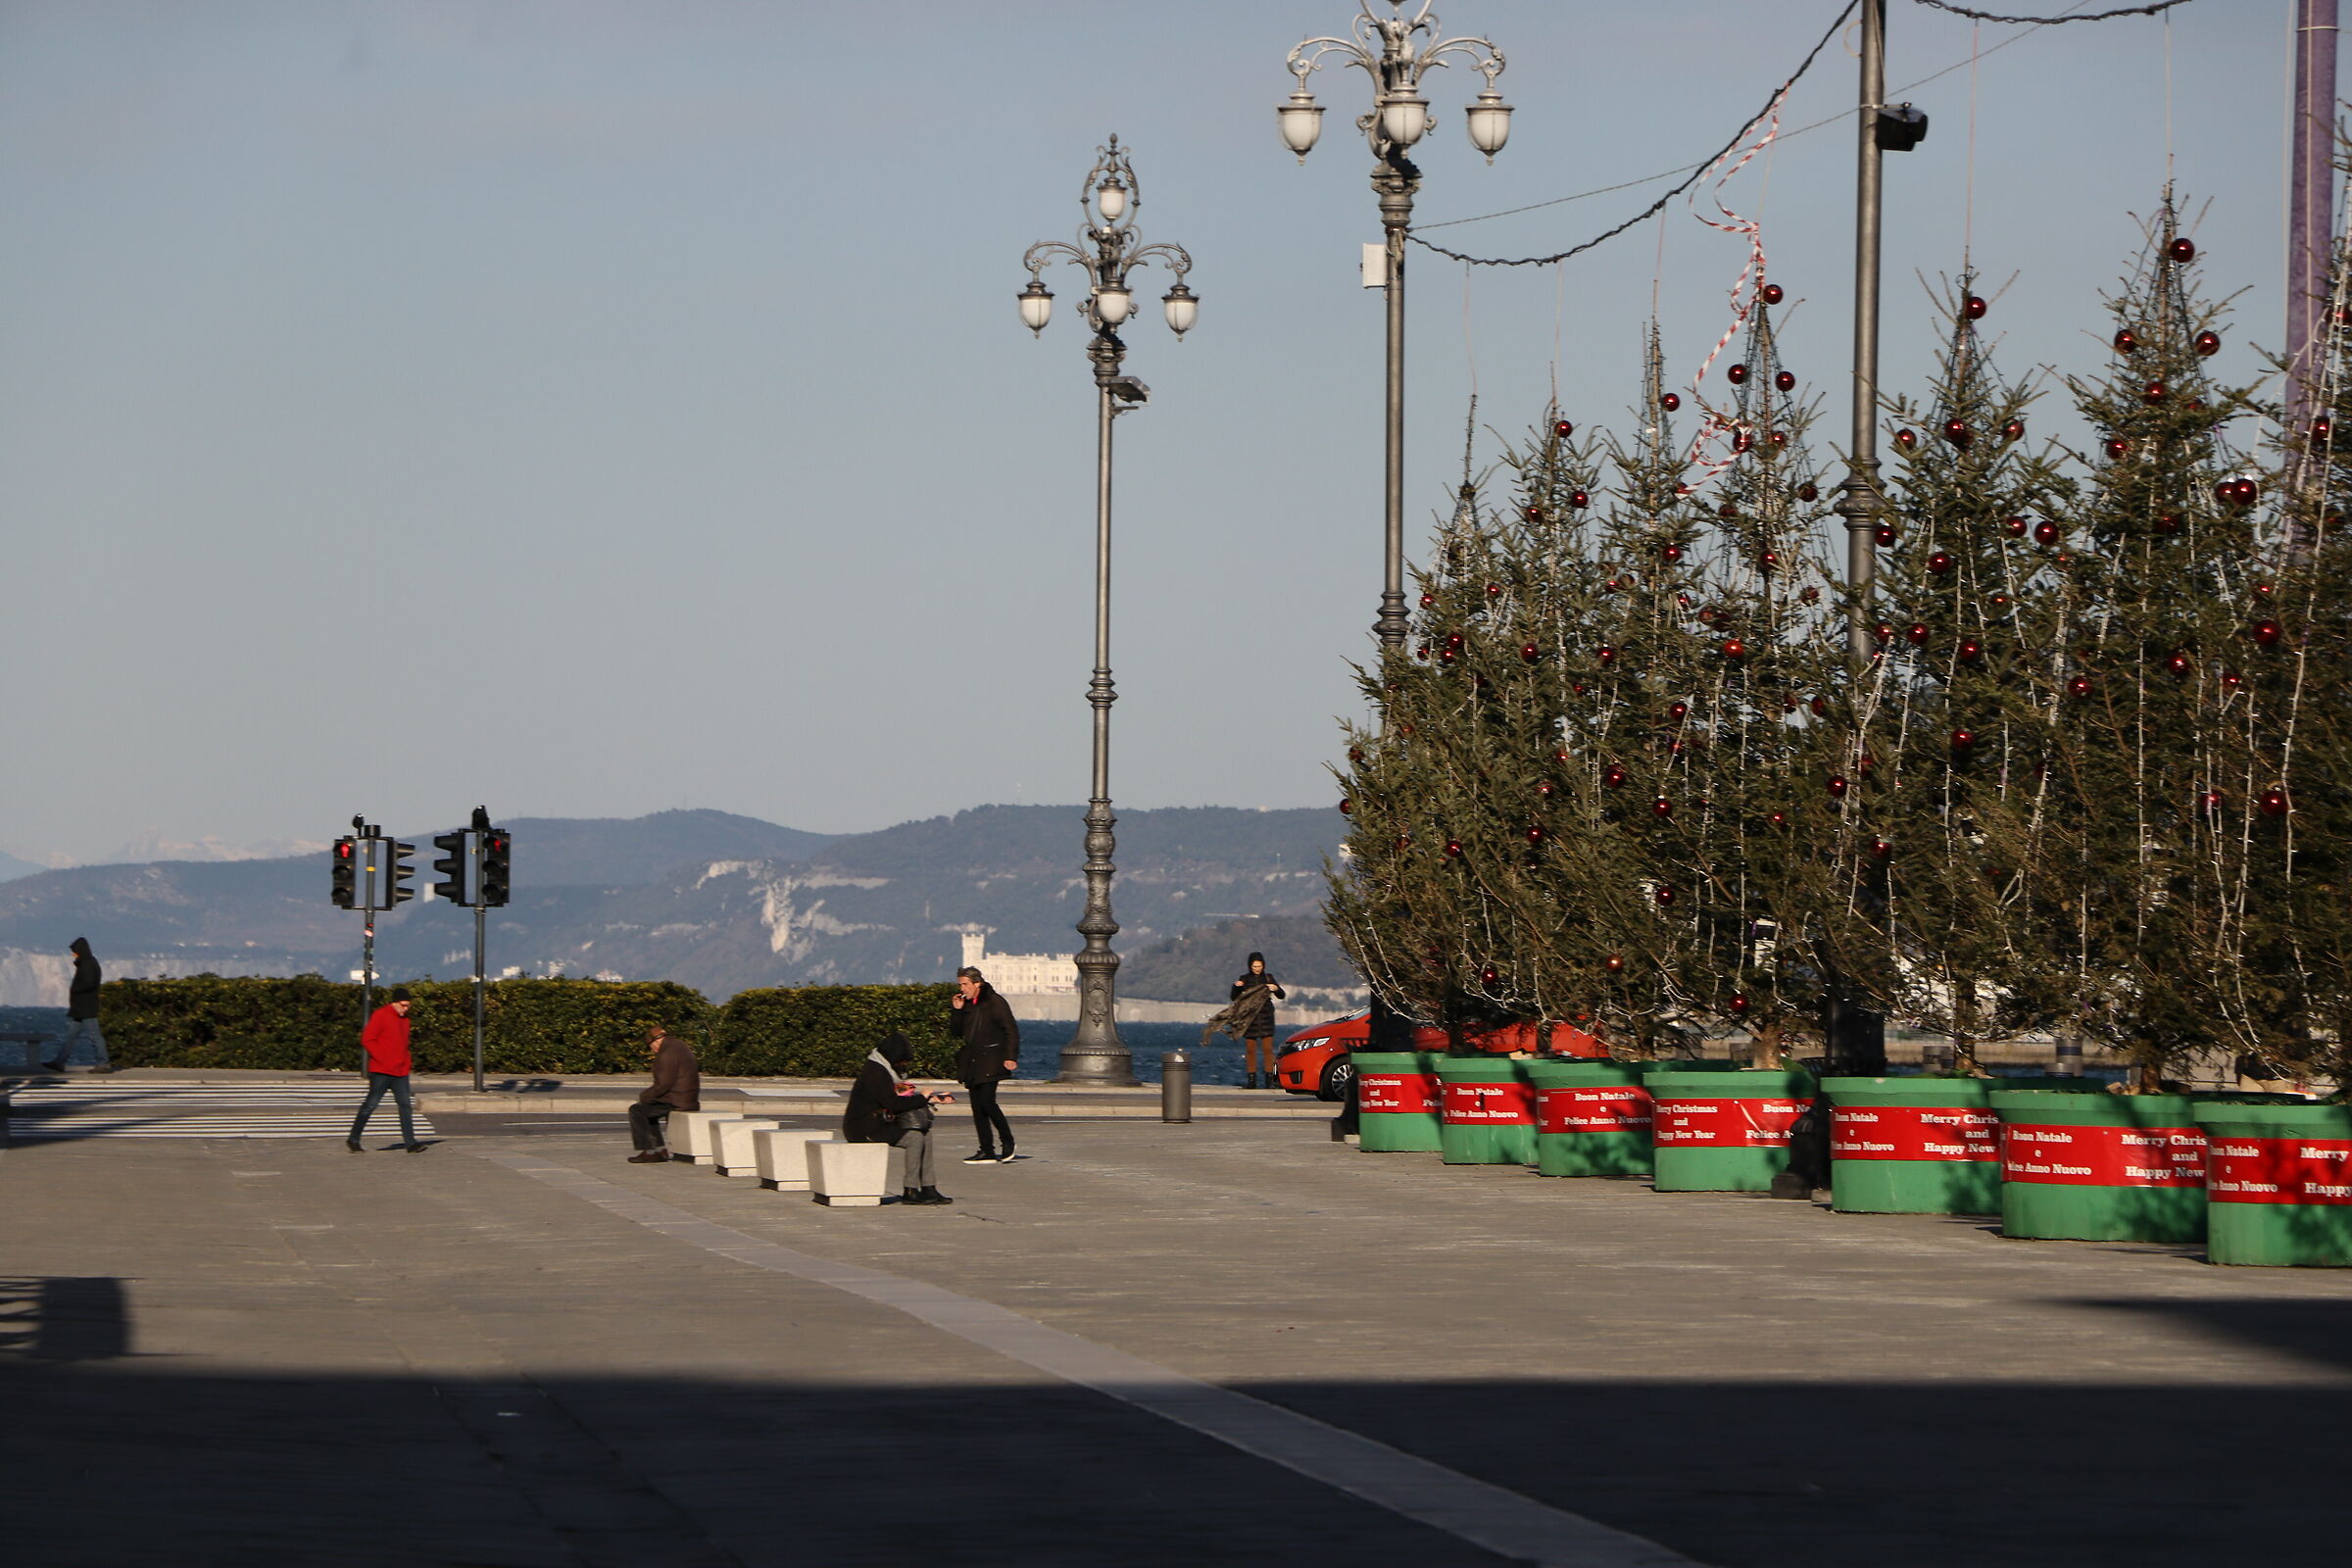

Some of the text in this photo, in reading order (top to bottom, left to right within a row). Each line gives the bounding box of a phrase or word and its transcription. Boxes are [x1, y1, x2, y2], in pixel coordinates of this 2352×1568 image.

[1575, 1092, 1636, 1102] Buon Natale
[1672, 1104, 1718, 1113] Christmas
[1762, 1103, 1794, 1113] Buon
[1489, 1109, 1519, 1118] Nuovo
[1849, 1112, 1879, 1122] Natale
[1564, 1115, 1651, 1125] Felice Anno Nuovo
[1673, 1117, 1689, 1126] and
[1920, 1113, 1999, 1126] Merry Chris
[1675, 1130, 1692, 1139] New
[1693, 1129, 1716, 1139] Year
[1744, 1129, 1781, 1139] Felice
[1965, 1129, 1990, 1139] and
[2035, 1131, 2073, 1143] Natale
[2121, 1134, 2208, 1148] Merry Chris
[1862, 1141, 1895, 1152] Nuovo
[1923, 1142, 1996, 1154] Happy New
[2226, 1145, 2260, 1157] Natale
[2172, 1152, 2198, 1161] and
[2299, 1147, 2350, 1162] Merry
[2025, 1162, 2051, 1174] Anno
[2052, 1163, 2092, 1175] Nuovo
[2125, 1165, 2205, 1180] Happy New
[2226, 1165, 2231, 1174] e
[2240, 1180, 2279, 1193] Nuovo
[2304, 1181, 2352, 1198] Happy
